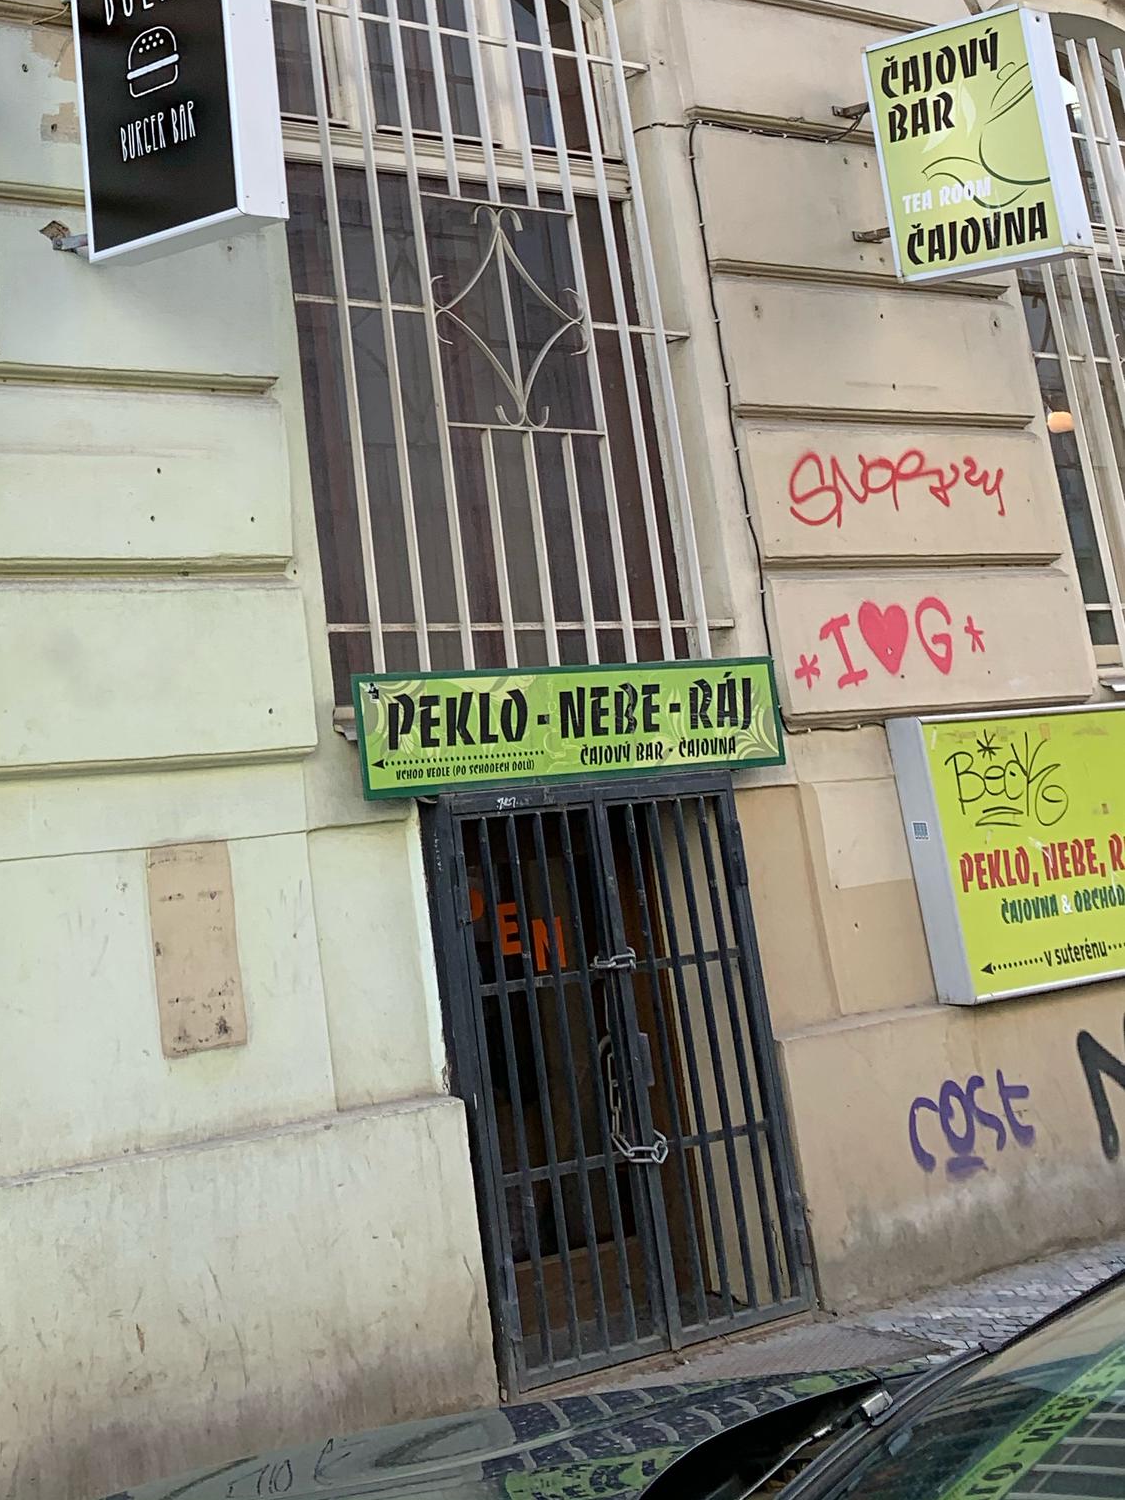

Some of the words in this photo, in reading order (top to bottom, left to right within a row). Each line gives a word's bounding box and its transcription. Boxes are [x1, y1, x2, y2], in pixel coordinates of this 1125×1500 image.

[881, 27, 1000, 99] ČAJOVÝ
[120, 110, 165, 162] BURGER
[172, 100, 196, 146] BAR
[888, 91, 955, 143] BAR
[902, 191, 933, 215] TEA
[939, 176, 992, 207] ROOM
[907, 201, 1049, 266] ČAJOVNA
[387, 688, 528, 750] PEKLO
[560, 683, 661, 738] NEBE
[689, 672, 752, 730] RÁJ
[396, 767, 424, 781] VCHOD
[426, 766, 450, 778] VEDLE
[453, 763, 467, 777] (PO
[469, 761, 510, 775] SCHODECH
[580, 741, 631, 765] ČAJOVÝ
[636, 741, 663, 761] BAR
[679, 736, 736, 757] ČAJOVNA
[960, 846, 1039, 892] PEKLO,
[1042, 839, 1106, 880] NEBE,
[1001, 894, 1059, 924] ČAJOVNA
[1061, 895, 1073, 914] &
[1044, 951, 1052, 967] v
[1055, 938, 1108, 965] suterénu
